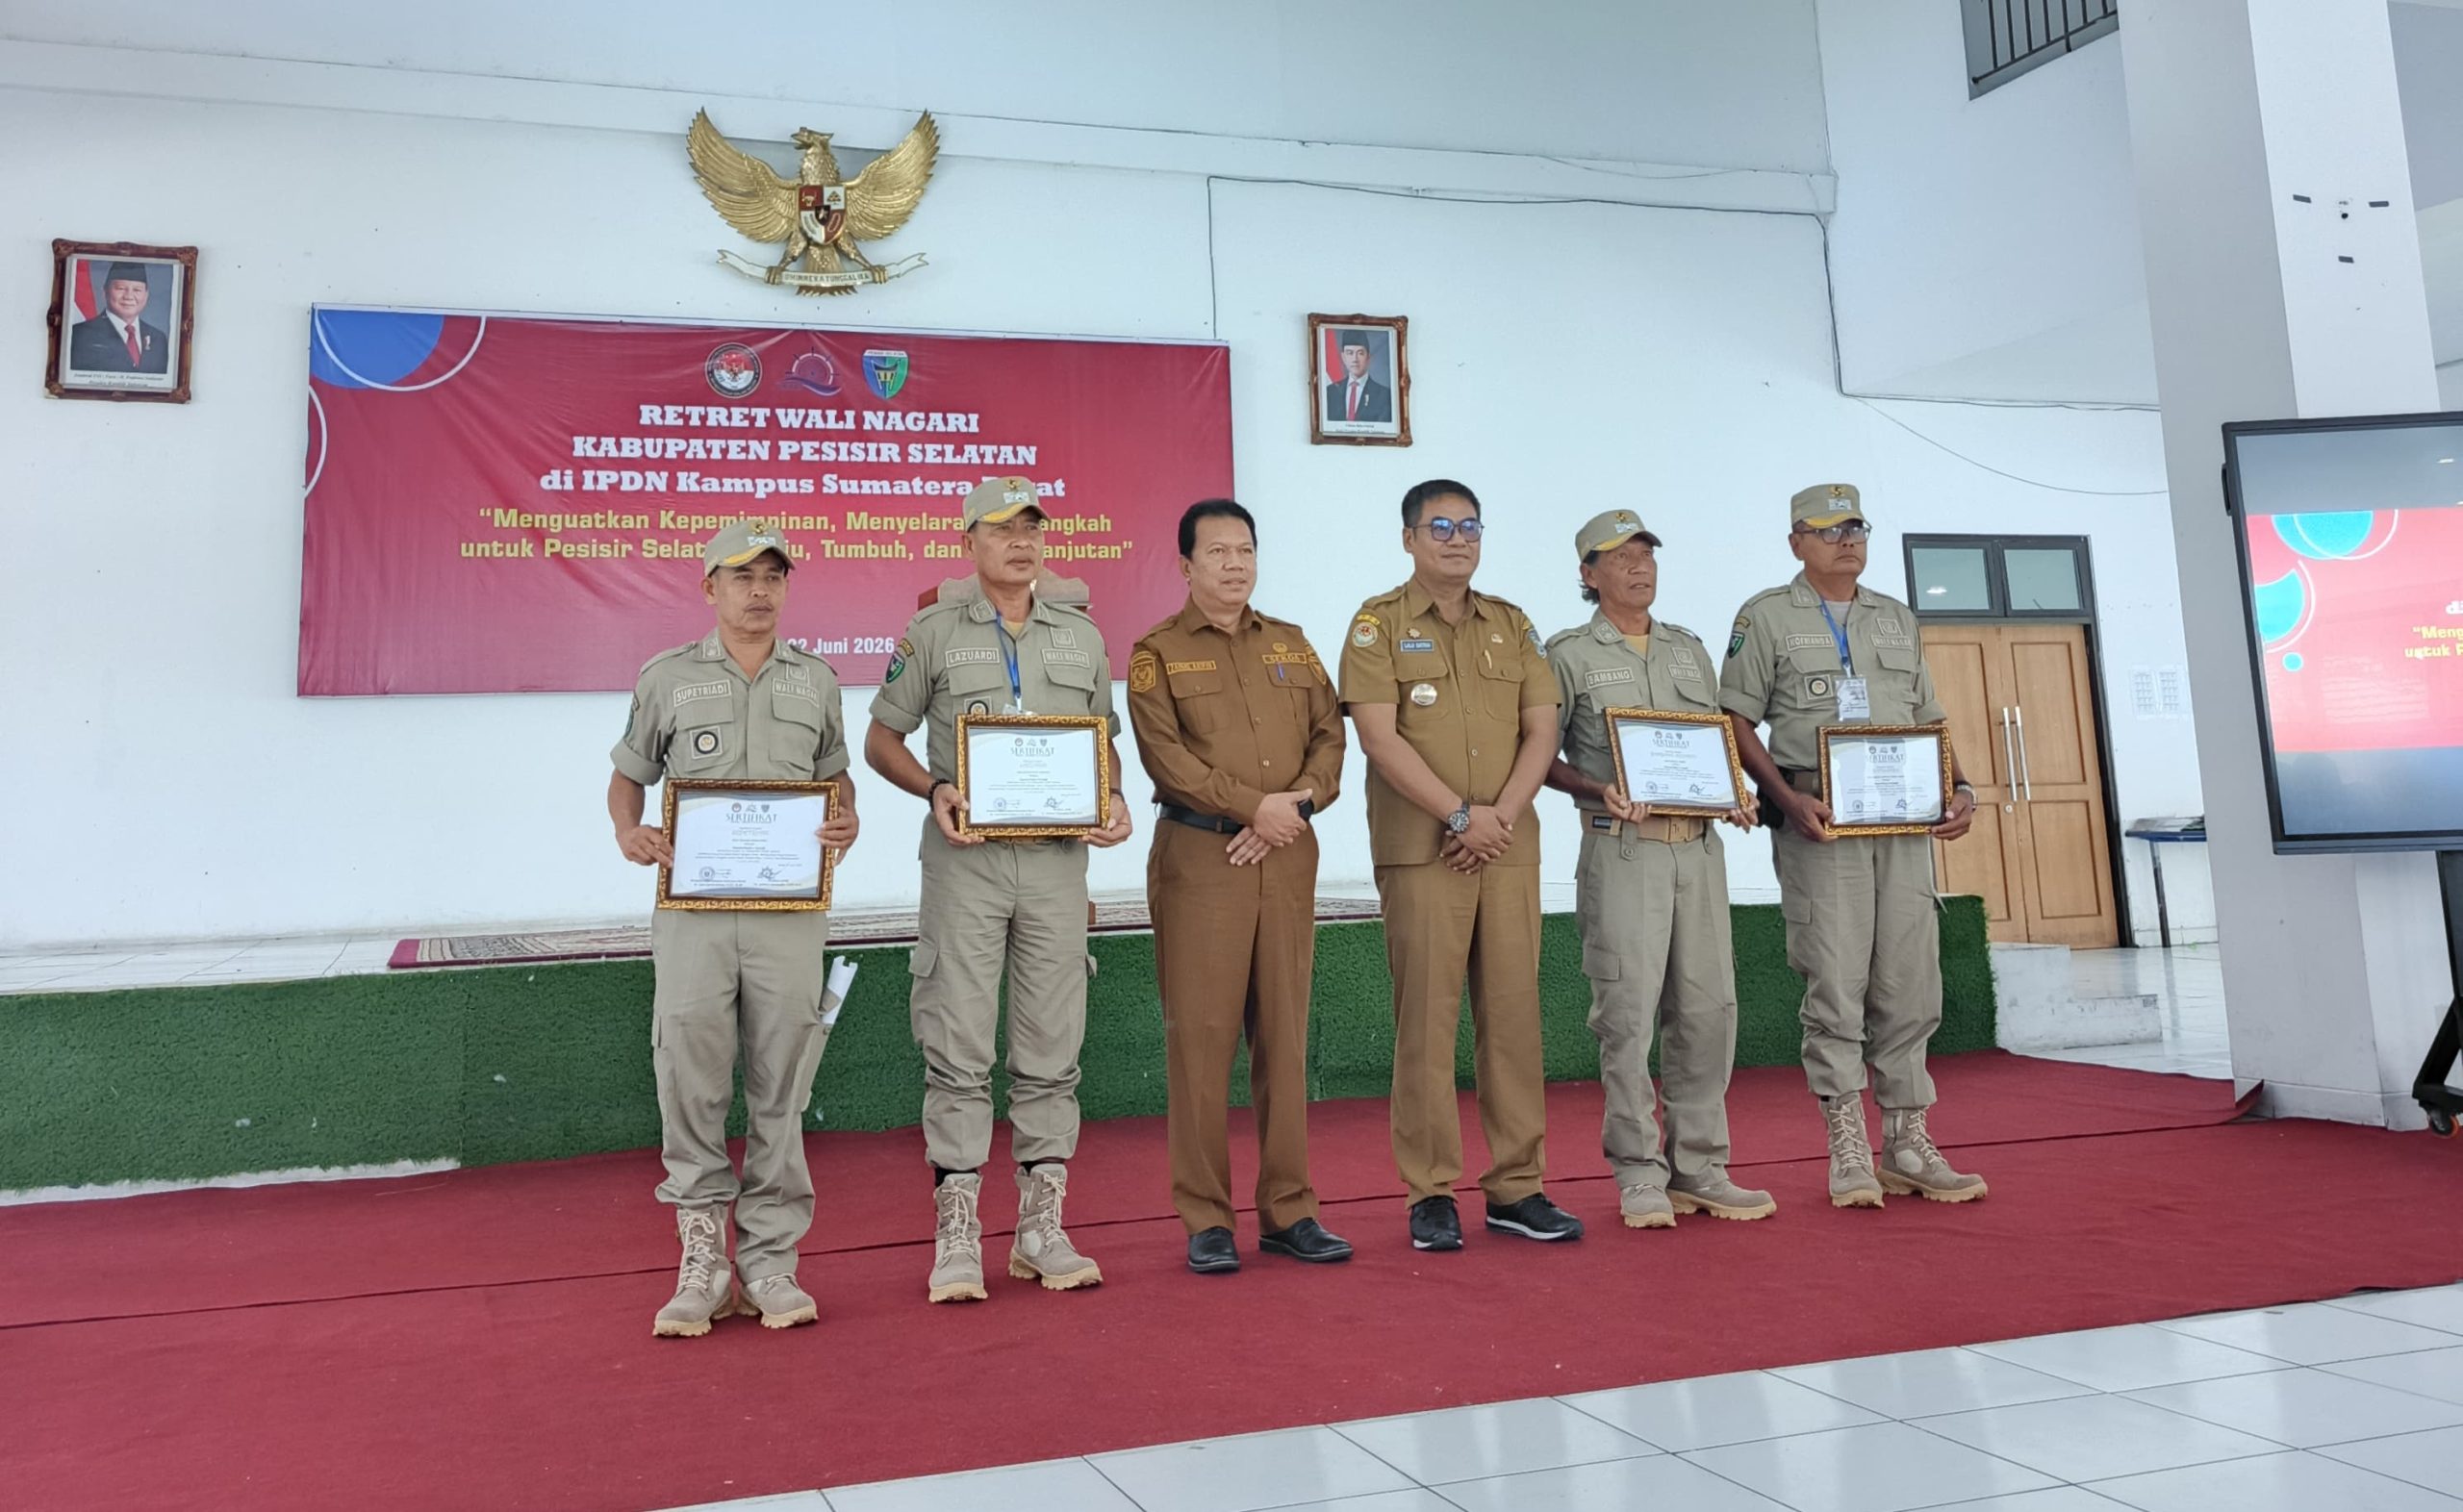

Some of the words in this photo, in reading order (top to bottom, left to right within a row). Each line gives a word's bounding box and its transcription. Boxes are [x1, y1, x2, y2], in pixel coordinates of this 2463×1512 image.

[639, 404, 771, 428] RETRET
[774, 408, 855, 430] WALI
[863, 410, 979, 433] NAGARI
[572, 436, 770, 461] KABUPATEN
[778, 441, 901, 464] PESISIR
[908, 443, 1037, 466] SELATAN
[540, 469, 573, 491] di
[582, 469, 669, 492] IPDN
[676, 472, 814, 498] Kampus
[822, 474, 974, 497] Sumatera
[479, 508, 649, 534] “Menguatkan
[847, 512, 965, 536] Menyelara
[1039, 514, 1112, 536] angkah
[461, 538, 534, 557] untuk
[544, 539, 633, 560] Pesisir
[641, 539, 706, 560] Selat
[785, 540, 811, 561] ju,
[821, 539, 914, 561] Tumbuh,
[924, 540, 962, 560] dan
[1042, 541, 1132, 562] anjutan”
[812, 637, 848, 654] Juni
[853, 637, 895, 654] 2026
[949, 650, 996, 663] LAZUARDI
[676, 683, 727, 702] SUPETRIADI
